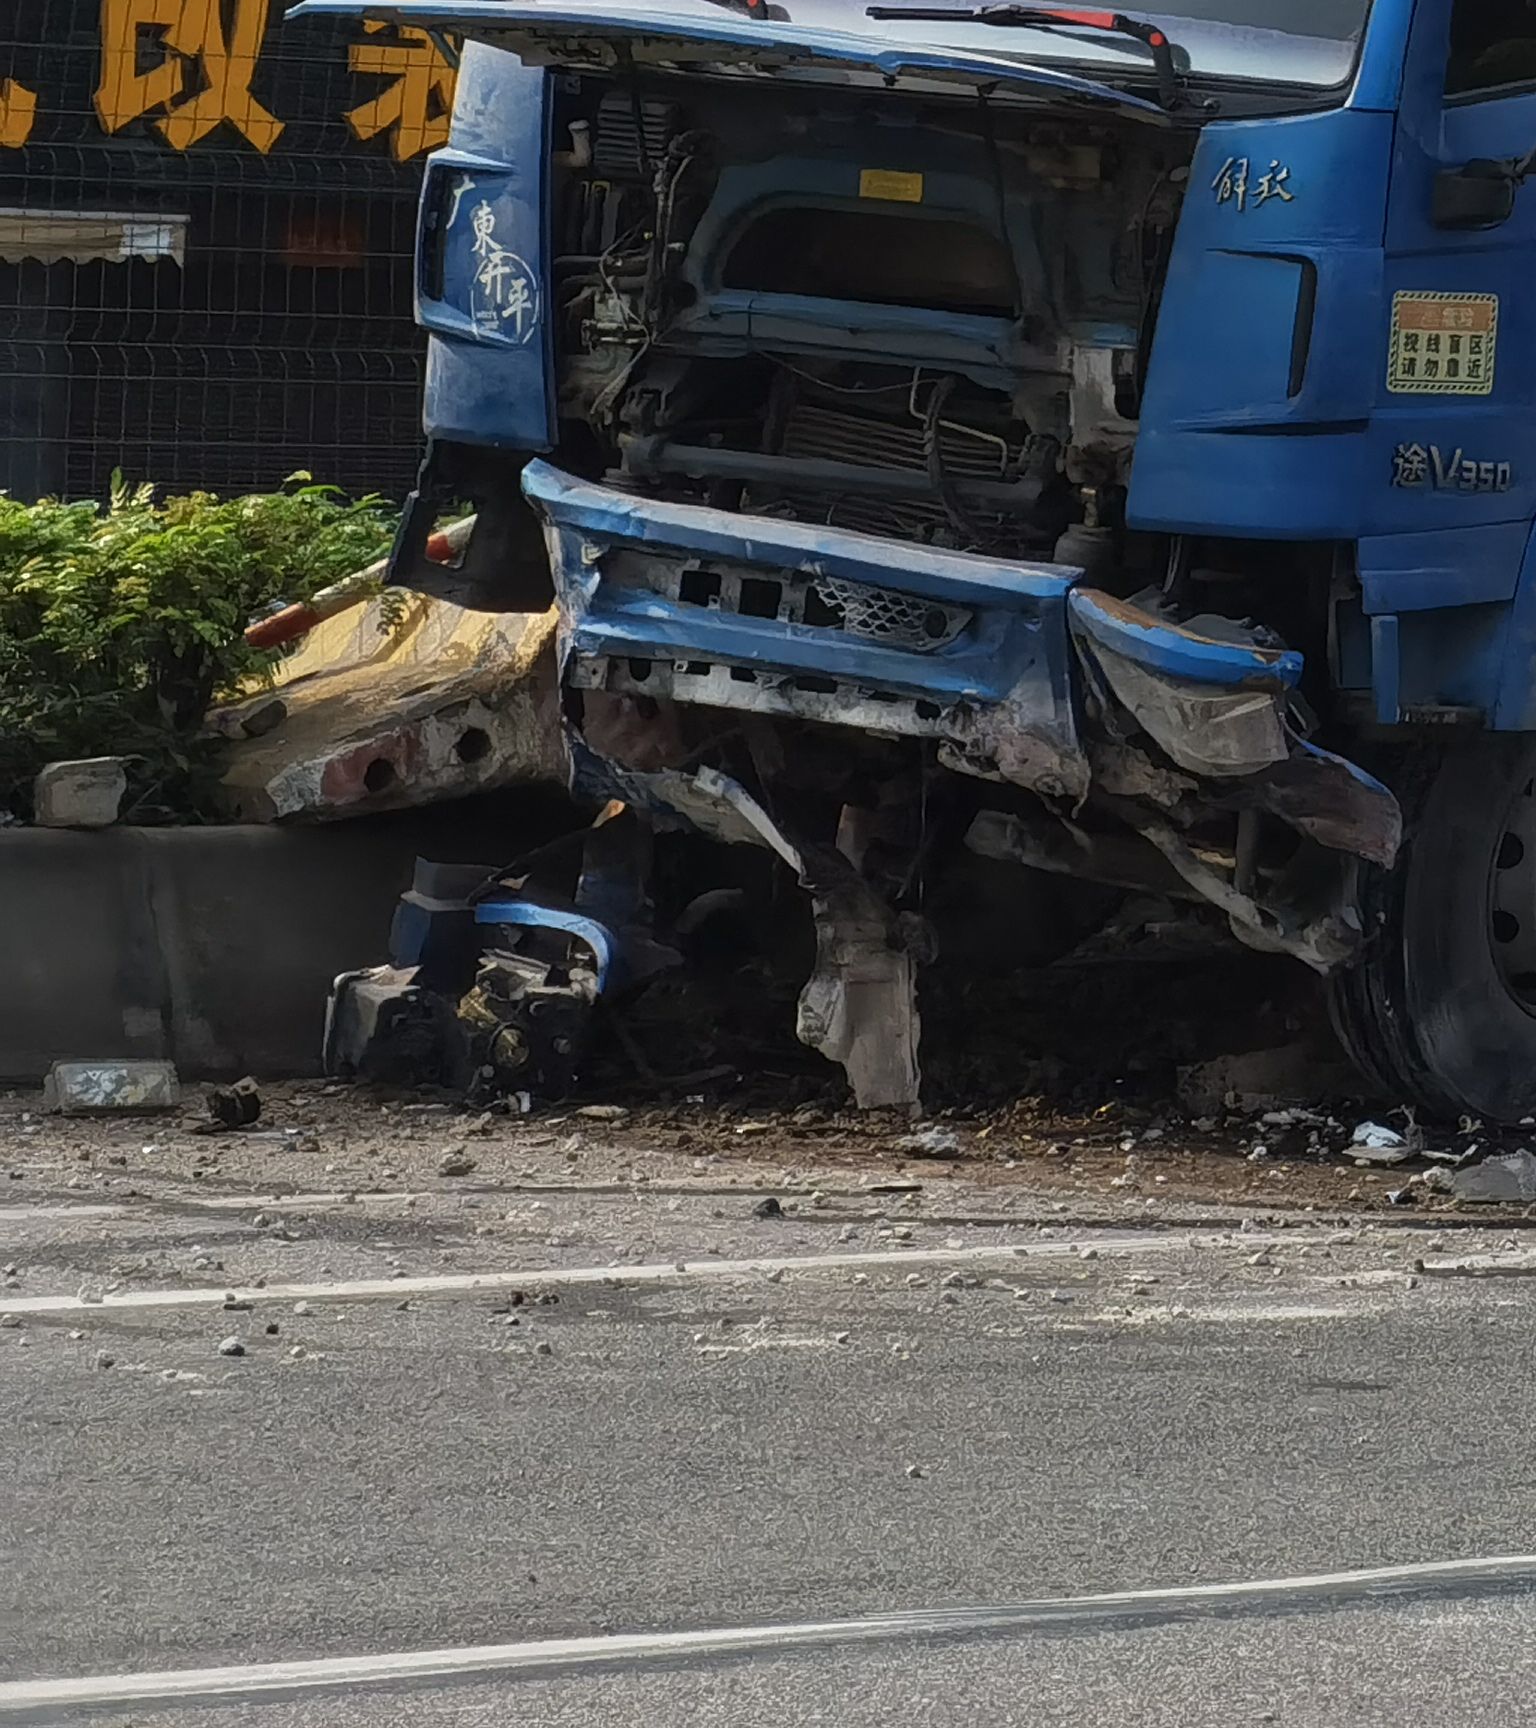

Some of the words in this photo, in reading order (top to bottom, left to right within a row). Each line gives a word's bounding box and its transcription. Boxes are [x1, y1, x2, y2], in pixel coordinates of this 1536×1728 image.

[1210, 156, 1293, 212] 解放
[1403, 332, 1484, 355] 视线盲区
